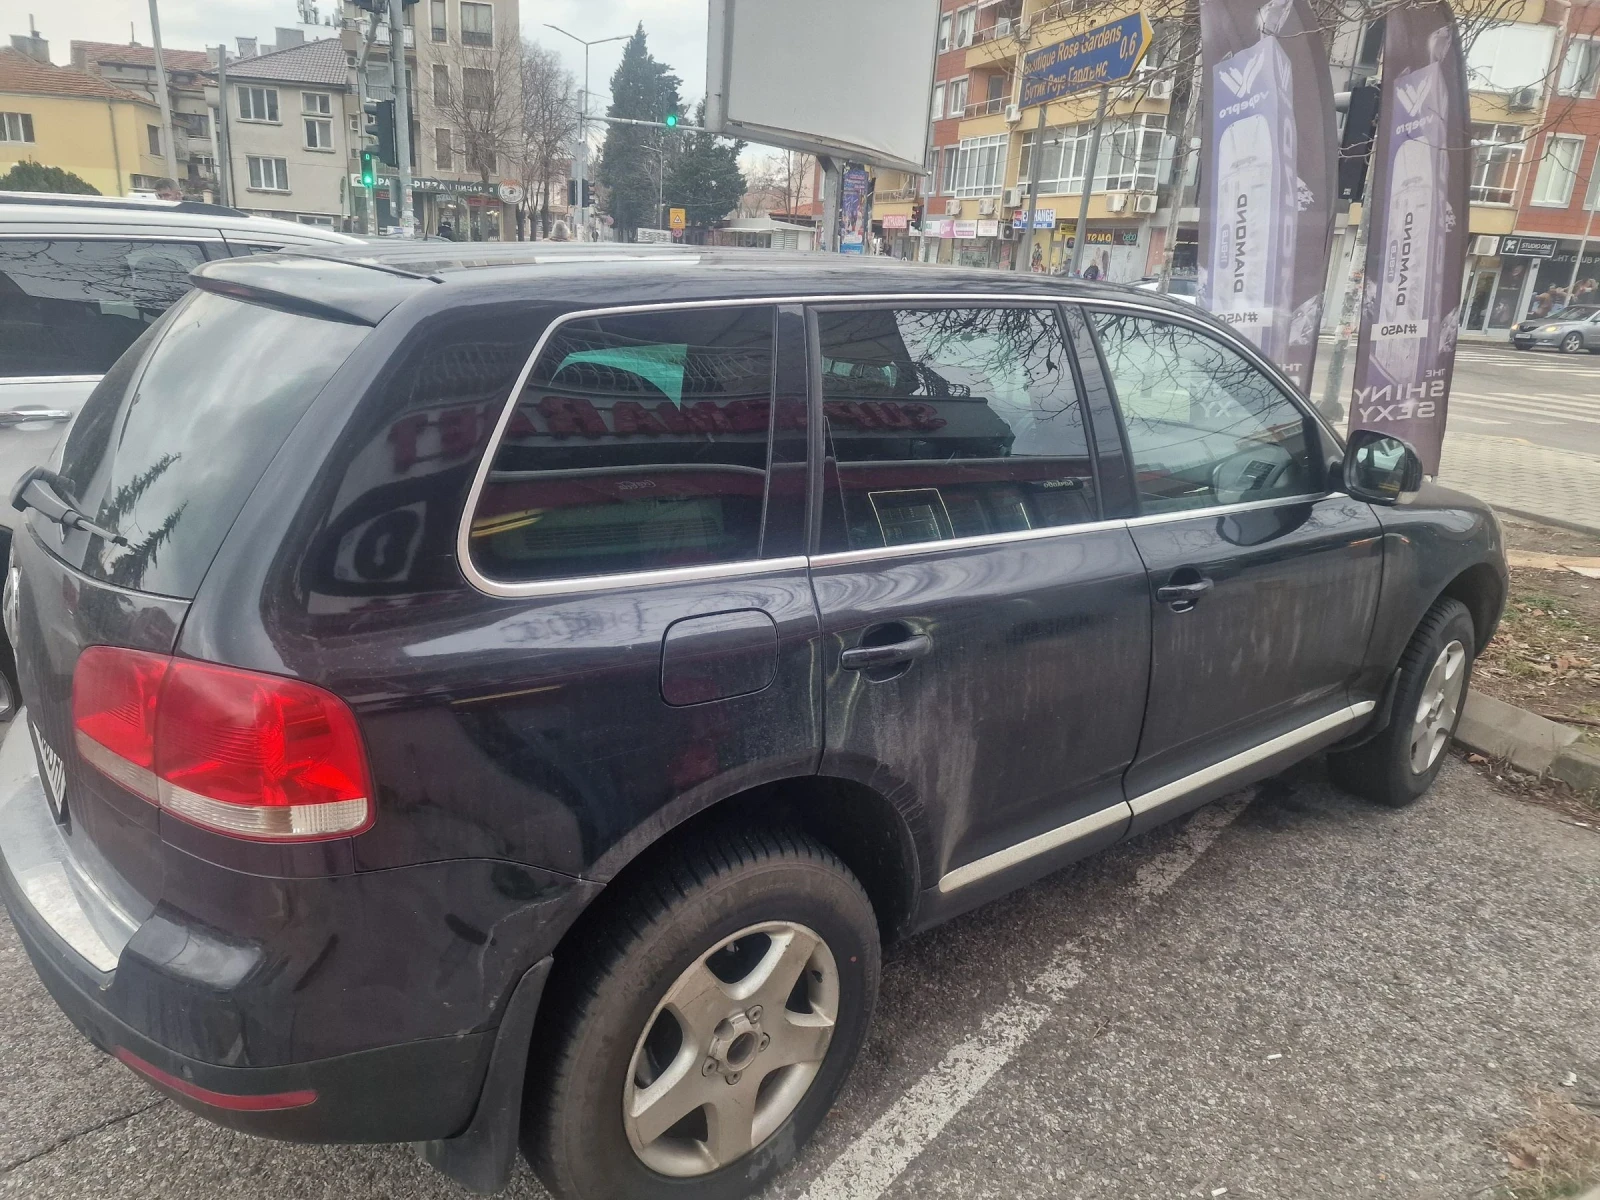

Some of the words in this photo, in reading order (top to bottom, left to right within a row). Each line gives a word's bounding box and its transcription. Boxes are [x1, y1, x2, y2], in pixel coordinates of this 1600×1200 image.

[1057, 41, 1080, 62] Rose
[1081, 25, 1122, 53] Gardens
[1119, 32, 1138, 61] 0,6
[1024, 81, 1047, 104] Бутик
[413, 180, 446, 190] PIZZA
[455, 184, 494, 193] ПИЦАРЯ
